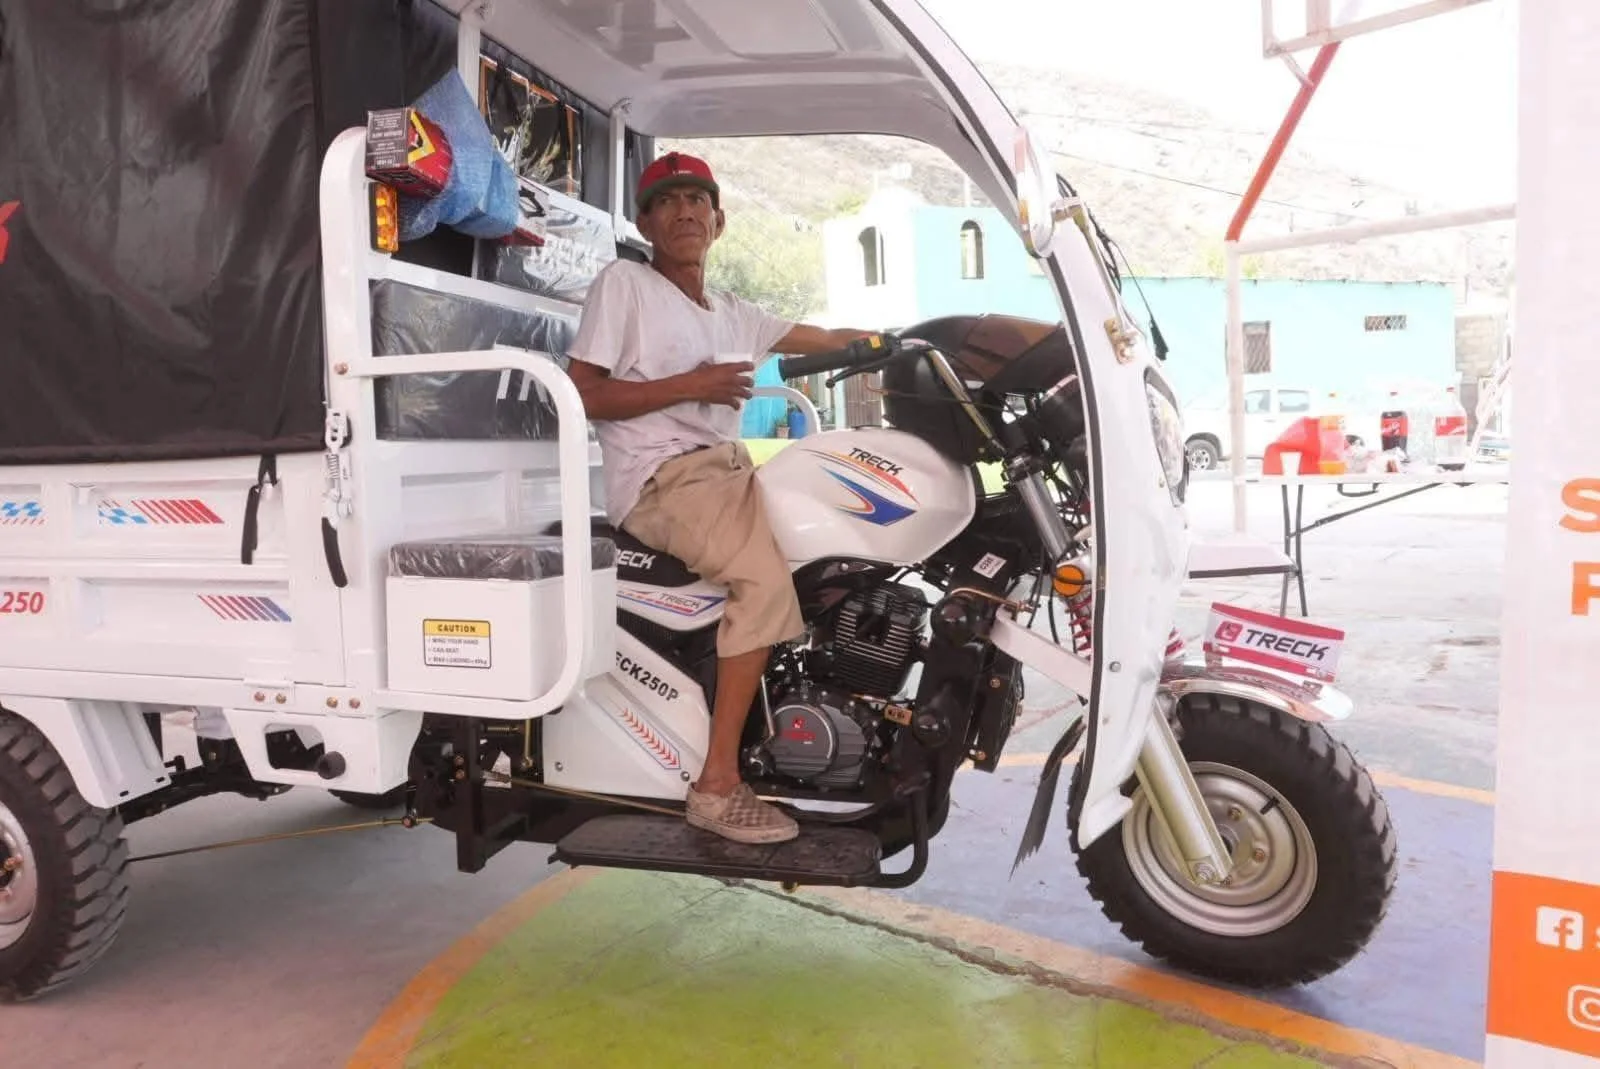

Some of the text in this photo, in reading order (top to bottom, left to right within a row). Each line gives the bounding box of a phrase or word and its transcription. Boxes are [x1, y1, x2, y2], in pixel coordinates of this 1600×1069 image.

[848, 447, 904, 476] TRECK
[0, 591, 44, 614] 250
[659, 592, 702, 609] TRECK
[437, 624, 476, 633] CAUTION
[1245, 628, 1330, 661] TRECK
